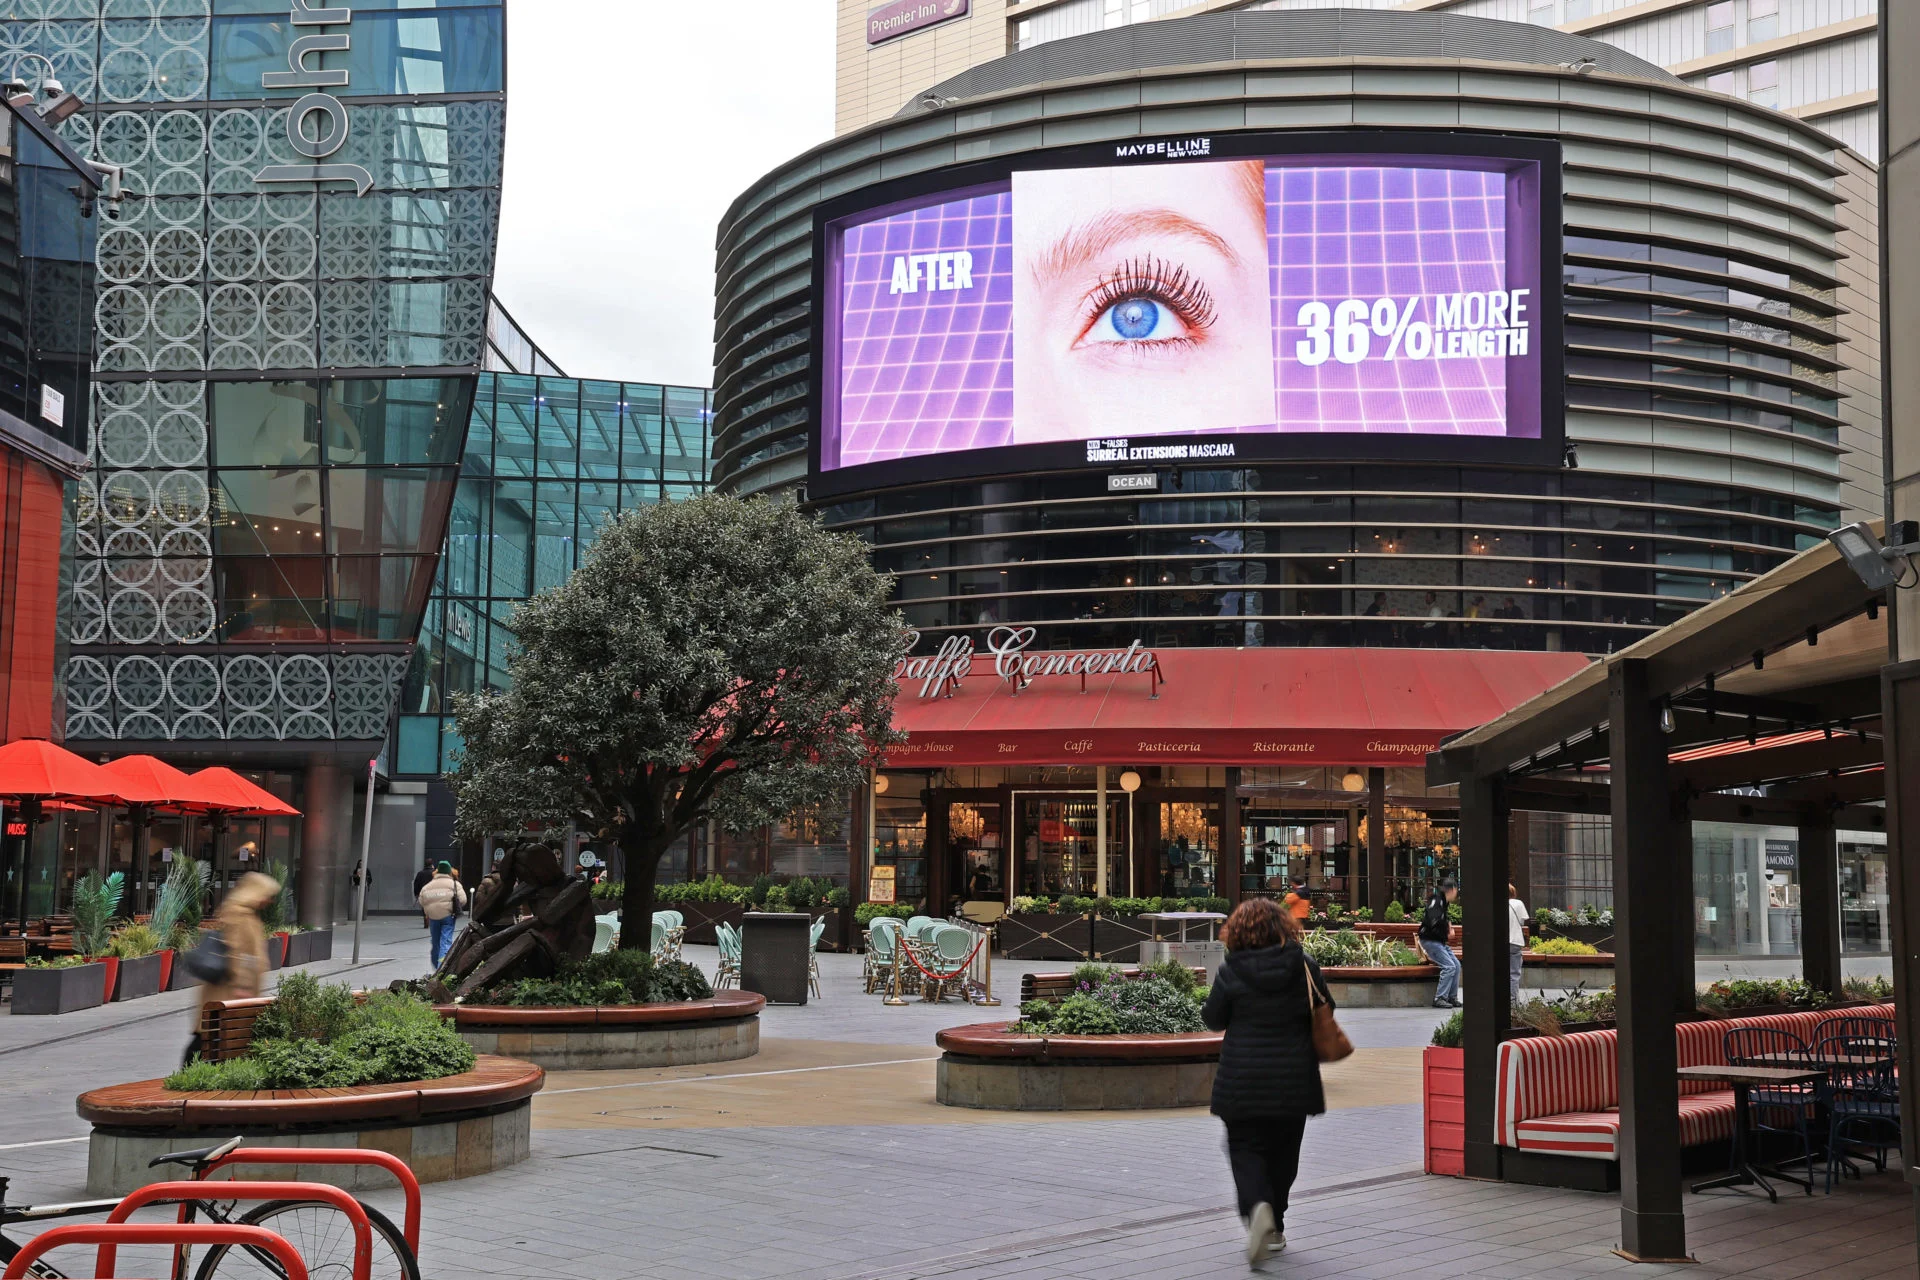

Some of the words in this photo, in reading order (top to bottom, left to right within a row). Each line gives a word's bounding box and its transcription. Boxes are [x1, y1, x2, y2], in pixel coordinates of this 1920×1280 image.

[871, 10, 916, 35] Premier
[918, 3, 937, 18] Inn
[1116, 138, 1211, 157] MAYBELLINE
[1187, 148, 1210, 156] YORK
[889, 250, 974, 295] AFTER
[1435, 289, 1531, 331] MORE
[1296, 296, 1432, 366] 36%
[1434, 328, 1529, 359] LENGTH
[1087, 448, 1128, 462] SURREAL
[1130, 445, 1188, 460] EXTENSIONS
[1189, 443, 1235, 458] MASCARA
[1112, 476, 1152, 487] OCEAN
[987, 626, 1157, 683] Concerto
[924, 742, 954, 752] House
[998, 743, 1018, 753] Bar
[1064, 739, 1093, 753] Caffé
[1137, 742, 1201, 752] Pasticceria
[1253, 742, 1315, 752] Ristorante
[1366, 741, 1435, 755] Champagne
[8, 823, 27, 835] MUSIC
